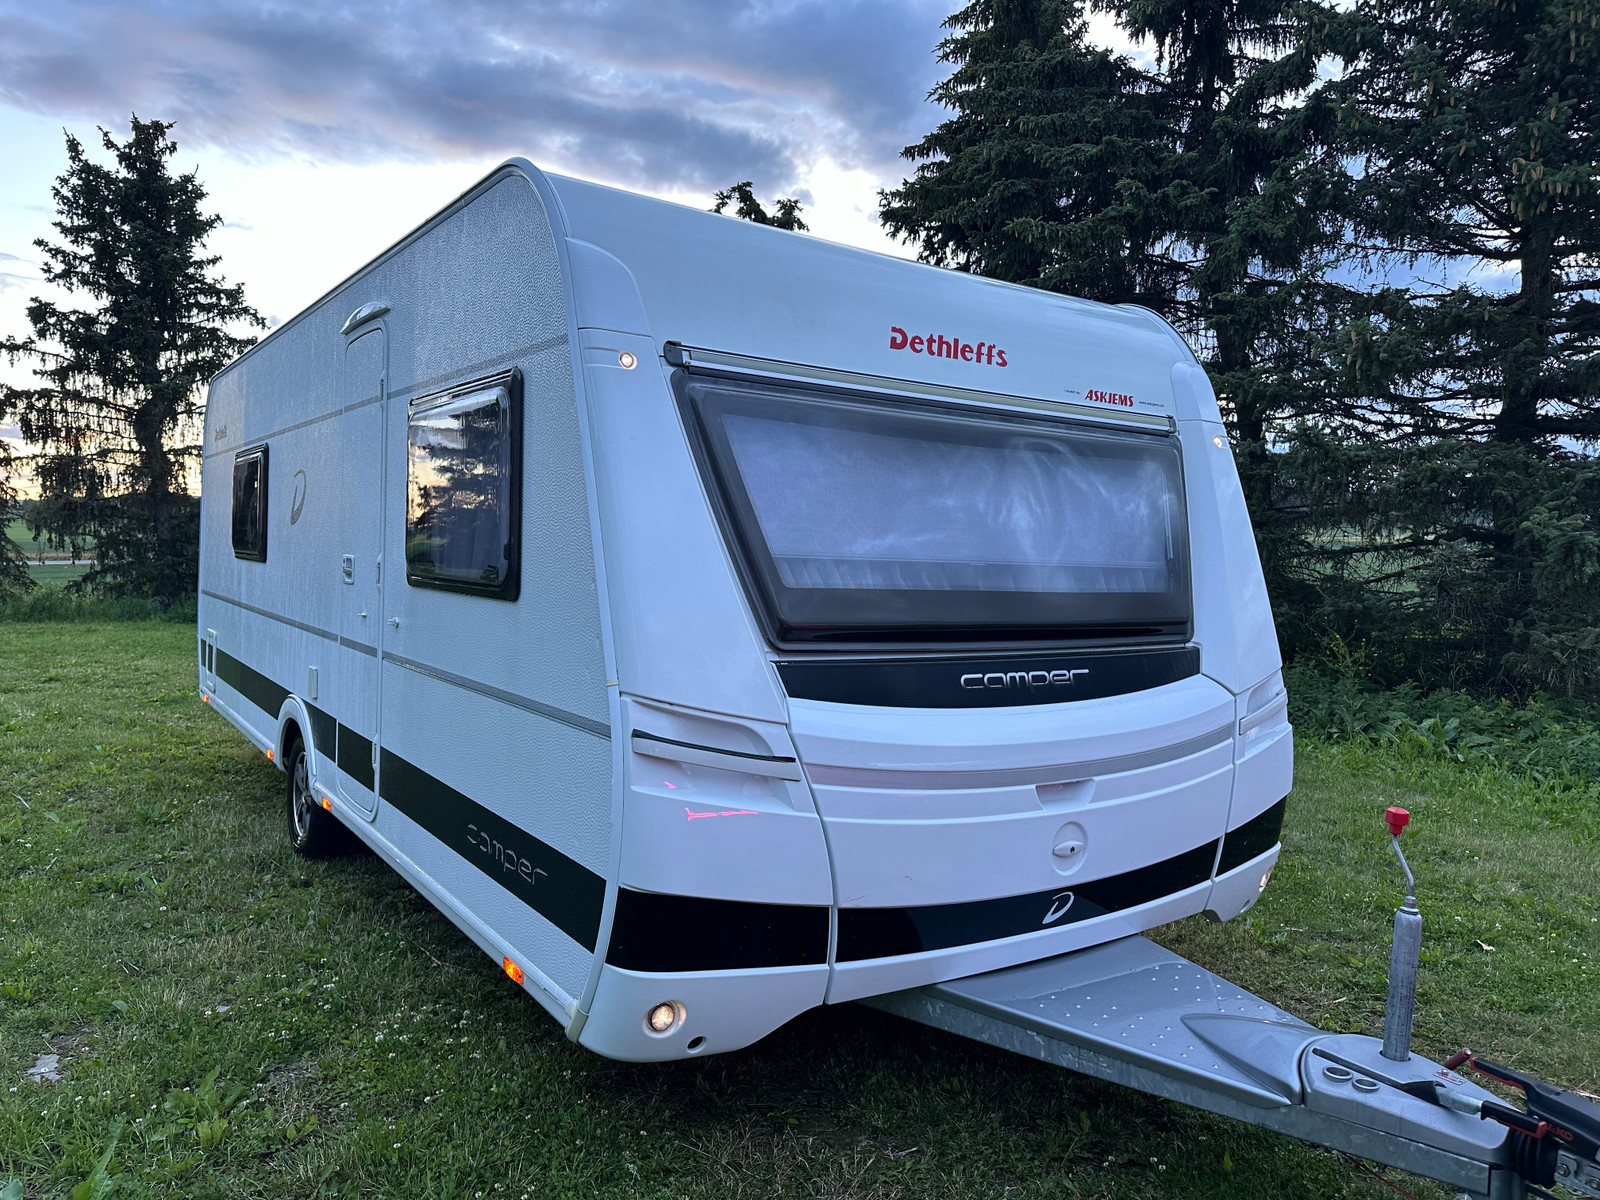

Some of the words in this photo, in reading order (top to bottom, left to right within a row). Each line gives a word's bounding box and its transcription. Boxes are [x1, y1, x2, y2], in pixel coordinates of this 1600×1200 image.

[889, 326, 1008, 367] Dethleffs
[1084, 389, 1134, 407] ASKJEMS
[960, 669, 1090, 693] camper
[466, 823, 549, 886] camper
